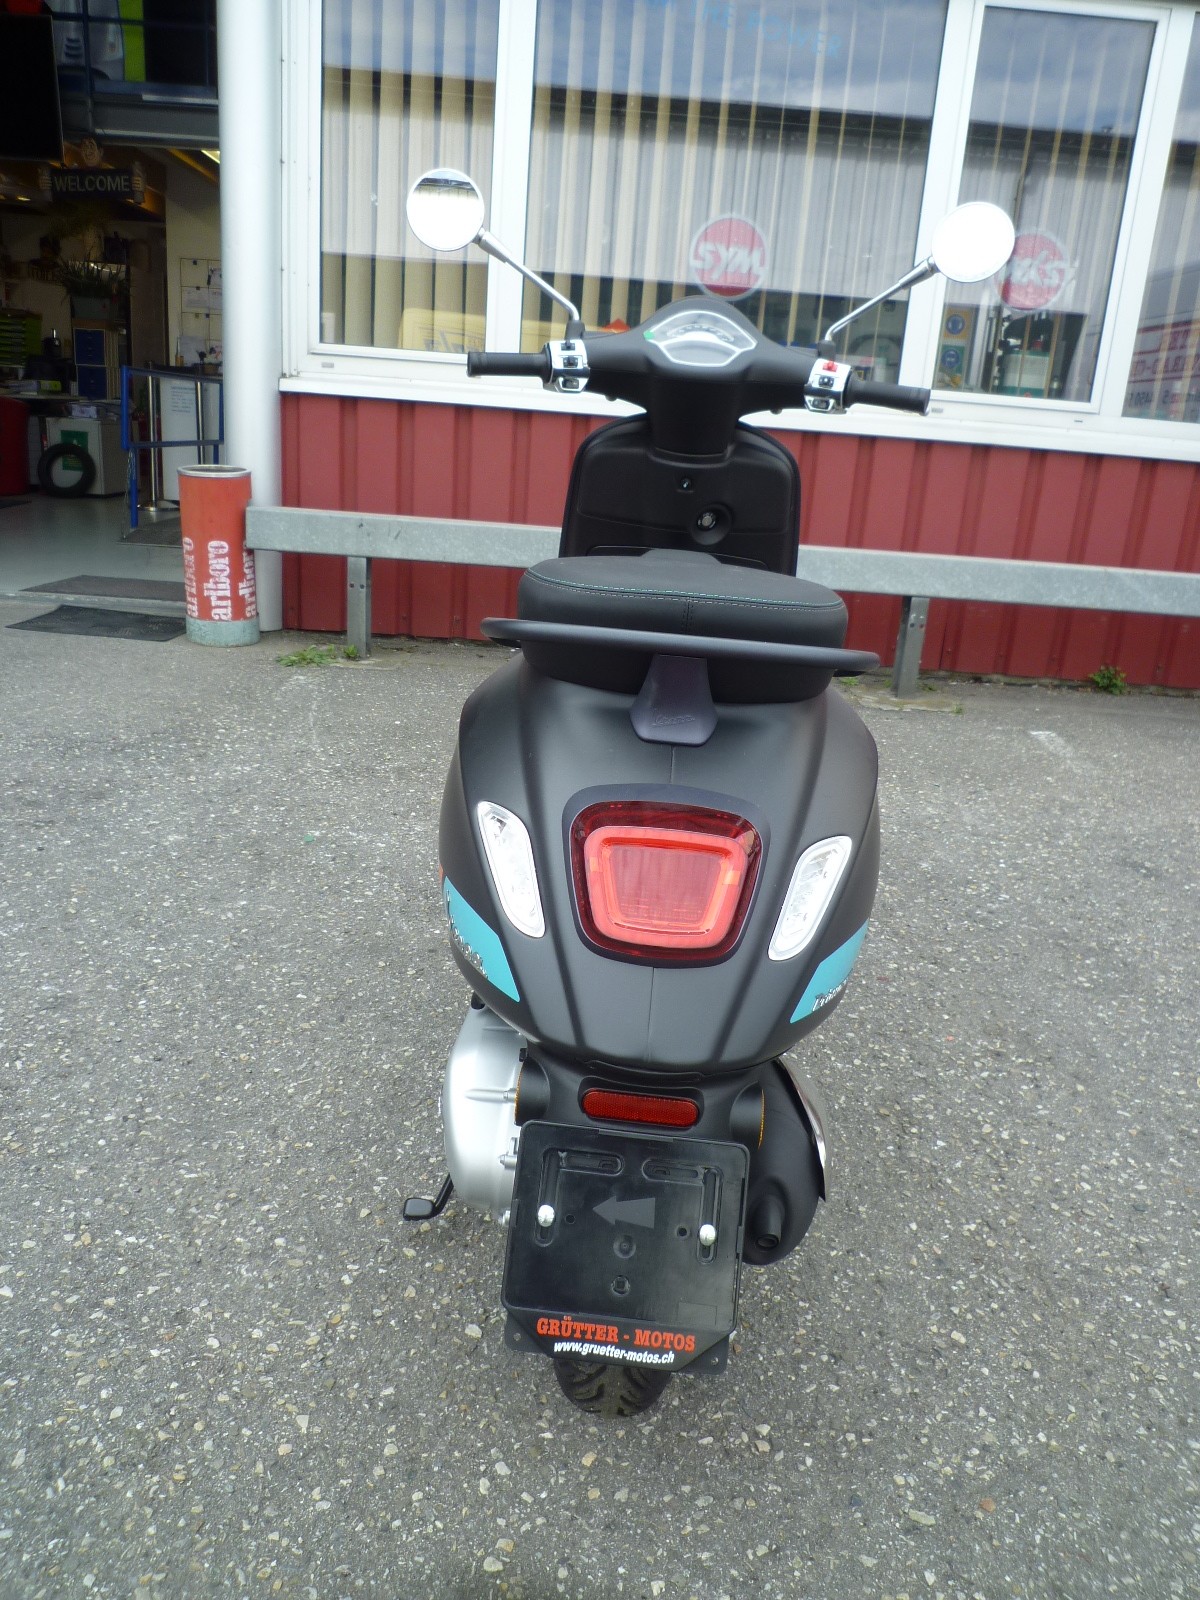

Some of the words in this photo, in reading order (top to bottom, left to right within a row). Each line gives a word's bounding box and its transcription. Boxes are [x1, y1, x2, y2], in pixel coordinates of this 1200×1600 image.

[54, 175, 130, 192] WELCOME
[691, 242, 767, 281] SYM
[536, 1315, 619, 1343] GRÜTTER
[634, 1328, 696, 1352] MOTOS
[553, 1340, 675, 1365] www.gruetter-motos.ch
